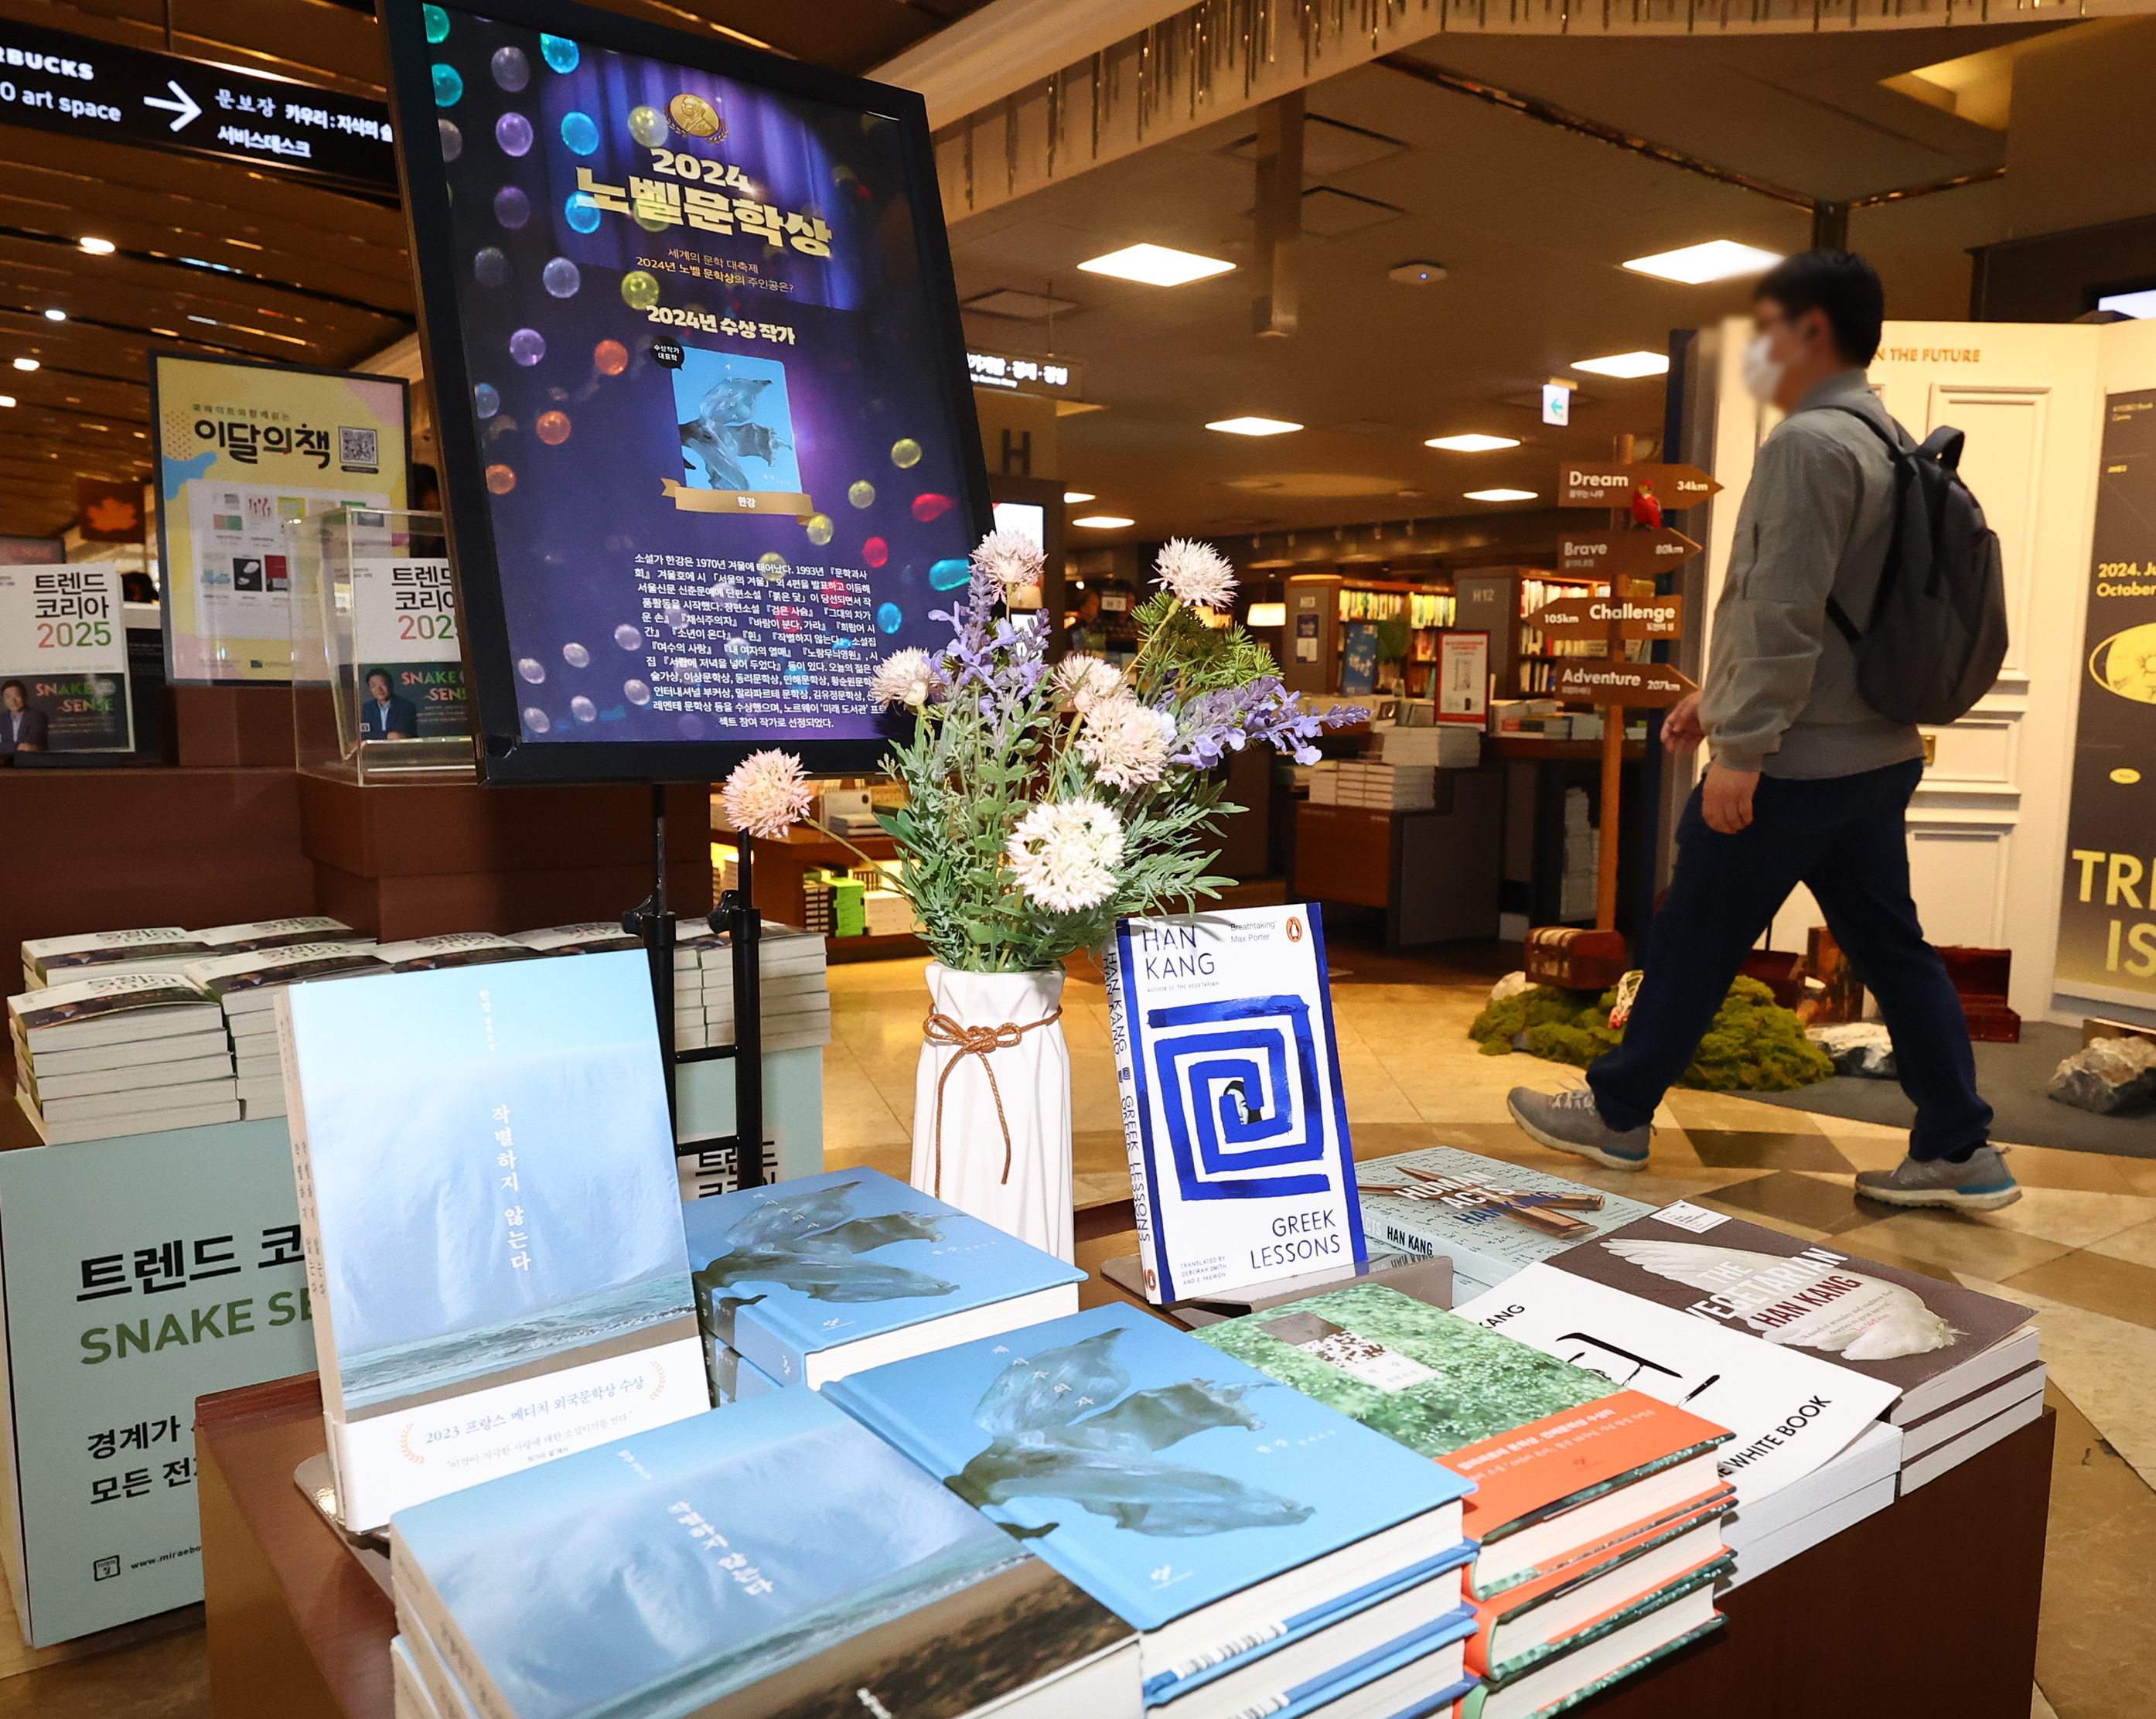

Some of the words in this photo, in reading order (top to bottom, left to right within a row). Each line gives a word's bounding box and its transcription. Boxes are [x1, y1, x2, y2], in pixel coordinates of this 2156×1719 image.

[22, 90, 54, 109] art
[59, 97, 121, 122] space
[217, 125, 312, 158] 서비스데스크
[650, 147, 753, 193] 2024
[576, 165, 833, 258] 노벨문학상
[668, 247, 701, 264] 세계의
[703, 254, 724, 268] 문학
[726, 259, 759, 275] 대축제
[636, 256, 677, 274] 2024년
[679, 263, 701, 278] 노벨
[703, 268, 745, 286] 문학상의
[748, 276, 794, 293] 주인공은?
[646, 305, 718, 333] 2024년
[720, 318, 756, 339] 수상
[759, 322, 796, 345] 작가
[1891, 349, 1919, 362] THE
[1922, 349, 1980, 363] FUTURE
[194, 419, 331, 469] 이달의책
[1569, 470, 1629, 488] Dream
[1677, 480, 1708, 492] 34km
[737, 496, 756, 508] 한강
[1564, 542, 1608, 556] Brave
[634, 554, 664, 565] 소설가
[665, 555, 694, 567] 한강은
[696, 558, 726, 570] 1970년
[728, 561, 754, 572] 겨울에
[756, 562, 794, 575] 태어났다.
[796, 565, 824, 576] 1993년
[2098, 561, 2141, 578] 2024.
[33, 572, 108, 595] 트렌드
[658, 569, 695, 582] 겨울호에
[698, 572, 706, 582] 시
[776, 578, 785, 588] 외
[786, 579, 810, 590] 4편을
[811, 581, 845, 592] 발표하고
[846, 583, 871, 594] 이듬해
[2096, 581, 2156, 597] October
[35, 595, 109, 619] 코리아
[637, 583, 676, 595] 서울신문
[679, 585, 725, 598] 신춘문예에
[725, 588, 762, 600] 단편소설
[820, 595, 861, 607] 당선되면서
[863, 597, 872, 607] 작
[642, 597, 681, 609] 품활동을
[683, 600, 722, 612] 시작했다.
[724, 602, 760, 614] 장편소설
[854, 610, 872, 621] 차가
[1544, 613, 1579, 624] 105km
[1589, 602, 1676, 622] Challenge
[37, 621, 111, 648] 2025
[397, 615, 458, 640] 202
[35, 680, 94, 697] SNAKE
[401, 670, 456, 685] SNAKE
[650, 671, 682, 683] 술가상,
[684, 672, 733, 684] 이상문학상,
[735, 674, 782, 685] 동리문학상,
[783, 675, 830, 687] 만해문학상,
[831, 677, 873, 687] 황순원문학
[1561, 667, 1641, 687] Adventure
[653, 686, 701, 697] 인터내셔널
[703, 687, 734, 699] 부커상,
[735, 688, 780, 700] 말라파르테
[782, 689, 811, 700] 문학상,
[813, 690, 865, 701] 김유정문학상,
[653, 701, 682, 711] 레멘테
[684, 701, 712, 712] 문학상
[715, 702, 733, 713] 등을
[735, 702, 783, 714] 수상했으며,
[784, 704, 820, 714] 노르웨이
[718, 717, 738, 727] 젝트
[739, 718, 758, 728] 참여
[759, 718, 786, 728] 작가로
[788, 718, 834, 728] 선정되었다.
[1142, 924, 1196, 952] HAN
[1146, 952, 1214, 980] KANG
[1107, 952, 1121, 991] HAN
[1114, 1000, 1127, 1052] KANG
[1126, 1095, 1139, 1151] GREEK
[1133, 1162, 1150, 1242] LESSONS
[491, 1104, 519, 1192] 작별하지
[1393, 1170, 1496, 1201] HUMAN
[1440, 1184, 1516, 1209] ACTS
[1272, 1209, 1336, 1237] GREEK
[1453, 1206, 1507, 1225] HAN
[504, 1206, 531, 1272] 않는다
[1250, 1234, 1340, 1269] LESSONS
[1387, 1226, 1406, 1247] HAN
[1408, 1235, 1433, 1256] KANG
[76, 1234, 241, 1301] 트렌드
[1180, 1258, 1217, 1269] TRANSLATED
[1182, 1268, 1209, 1277] DEBORAH
[1210, 1264, 1226, 1272] SMITH
[1697, 1261, 1754, 1284] THE
[1750, 1301, 1812, 1328] HAN
[1793, 1275, 1864, 1307] KANG
[80, 1299, 254, 1364] SNAKE
[425, 1426, 459, 1444] 2023
[466, 1415, 507, 1434] 프랑스
[510, 1400, 549, 1421] 메디치
[554, 1383, 616, 1410] 외국문학상
[619, 1375, 644, 1393] 수상
[87, 1416, 181, 1459] 경계가
[1723, 1434, 1785, 1468] WHITE
[1775, 1395, 1832, 1437] BOOK
[90, 1468, 152, 1506] 모든
[163, 1458, 198, 1488] 전
